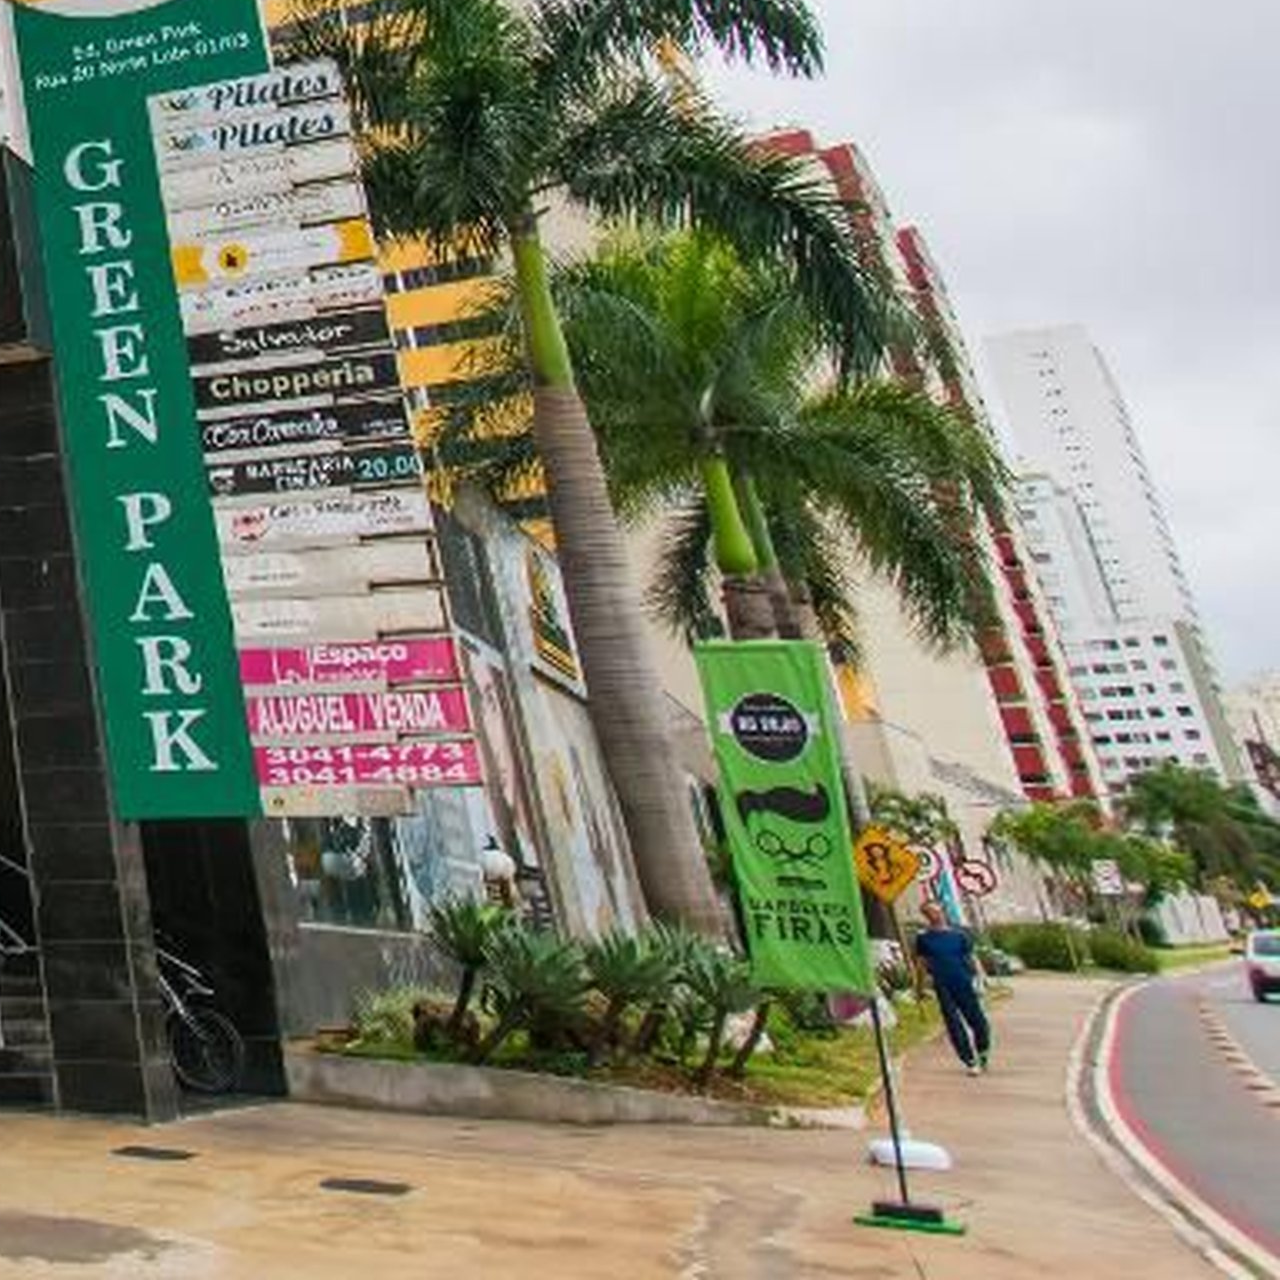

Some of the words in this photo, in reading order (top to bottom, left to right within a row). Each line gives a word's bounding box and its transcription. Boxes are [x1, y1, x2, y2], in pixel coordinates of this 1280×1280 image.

[206, 72, 331, 111] Pilates
[212, 113, 336, 151] Pilates
[209, 362, 375, 400] Chopperia
[64, 140, 160, 448] GREEN
[116, 492, 218, 771] PARK
[256, 692, 355, 734] ALUGUEL
[367, 691, 446, 732] VENDA
[265, 742, 465, 764] 3041-4773
[268, 764, 469, 786] 3041-4884
[752, 913, 854, 946] FIRAS
